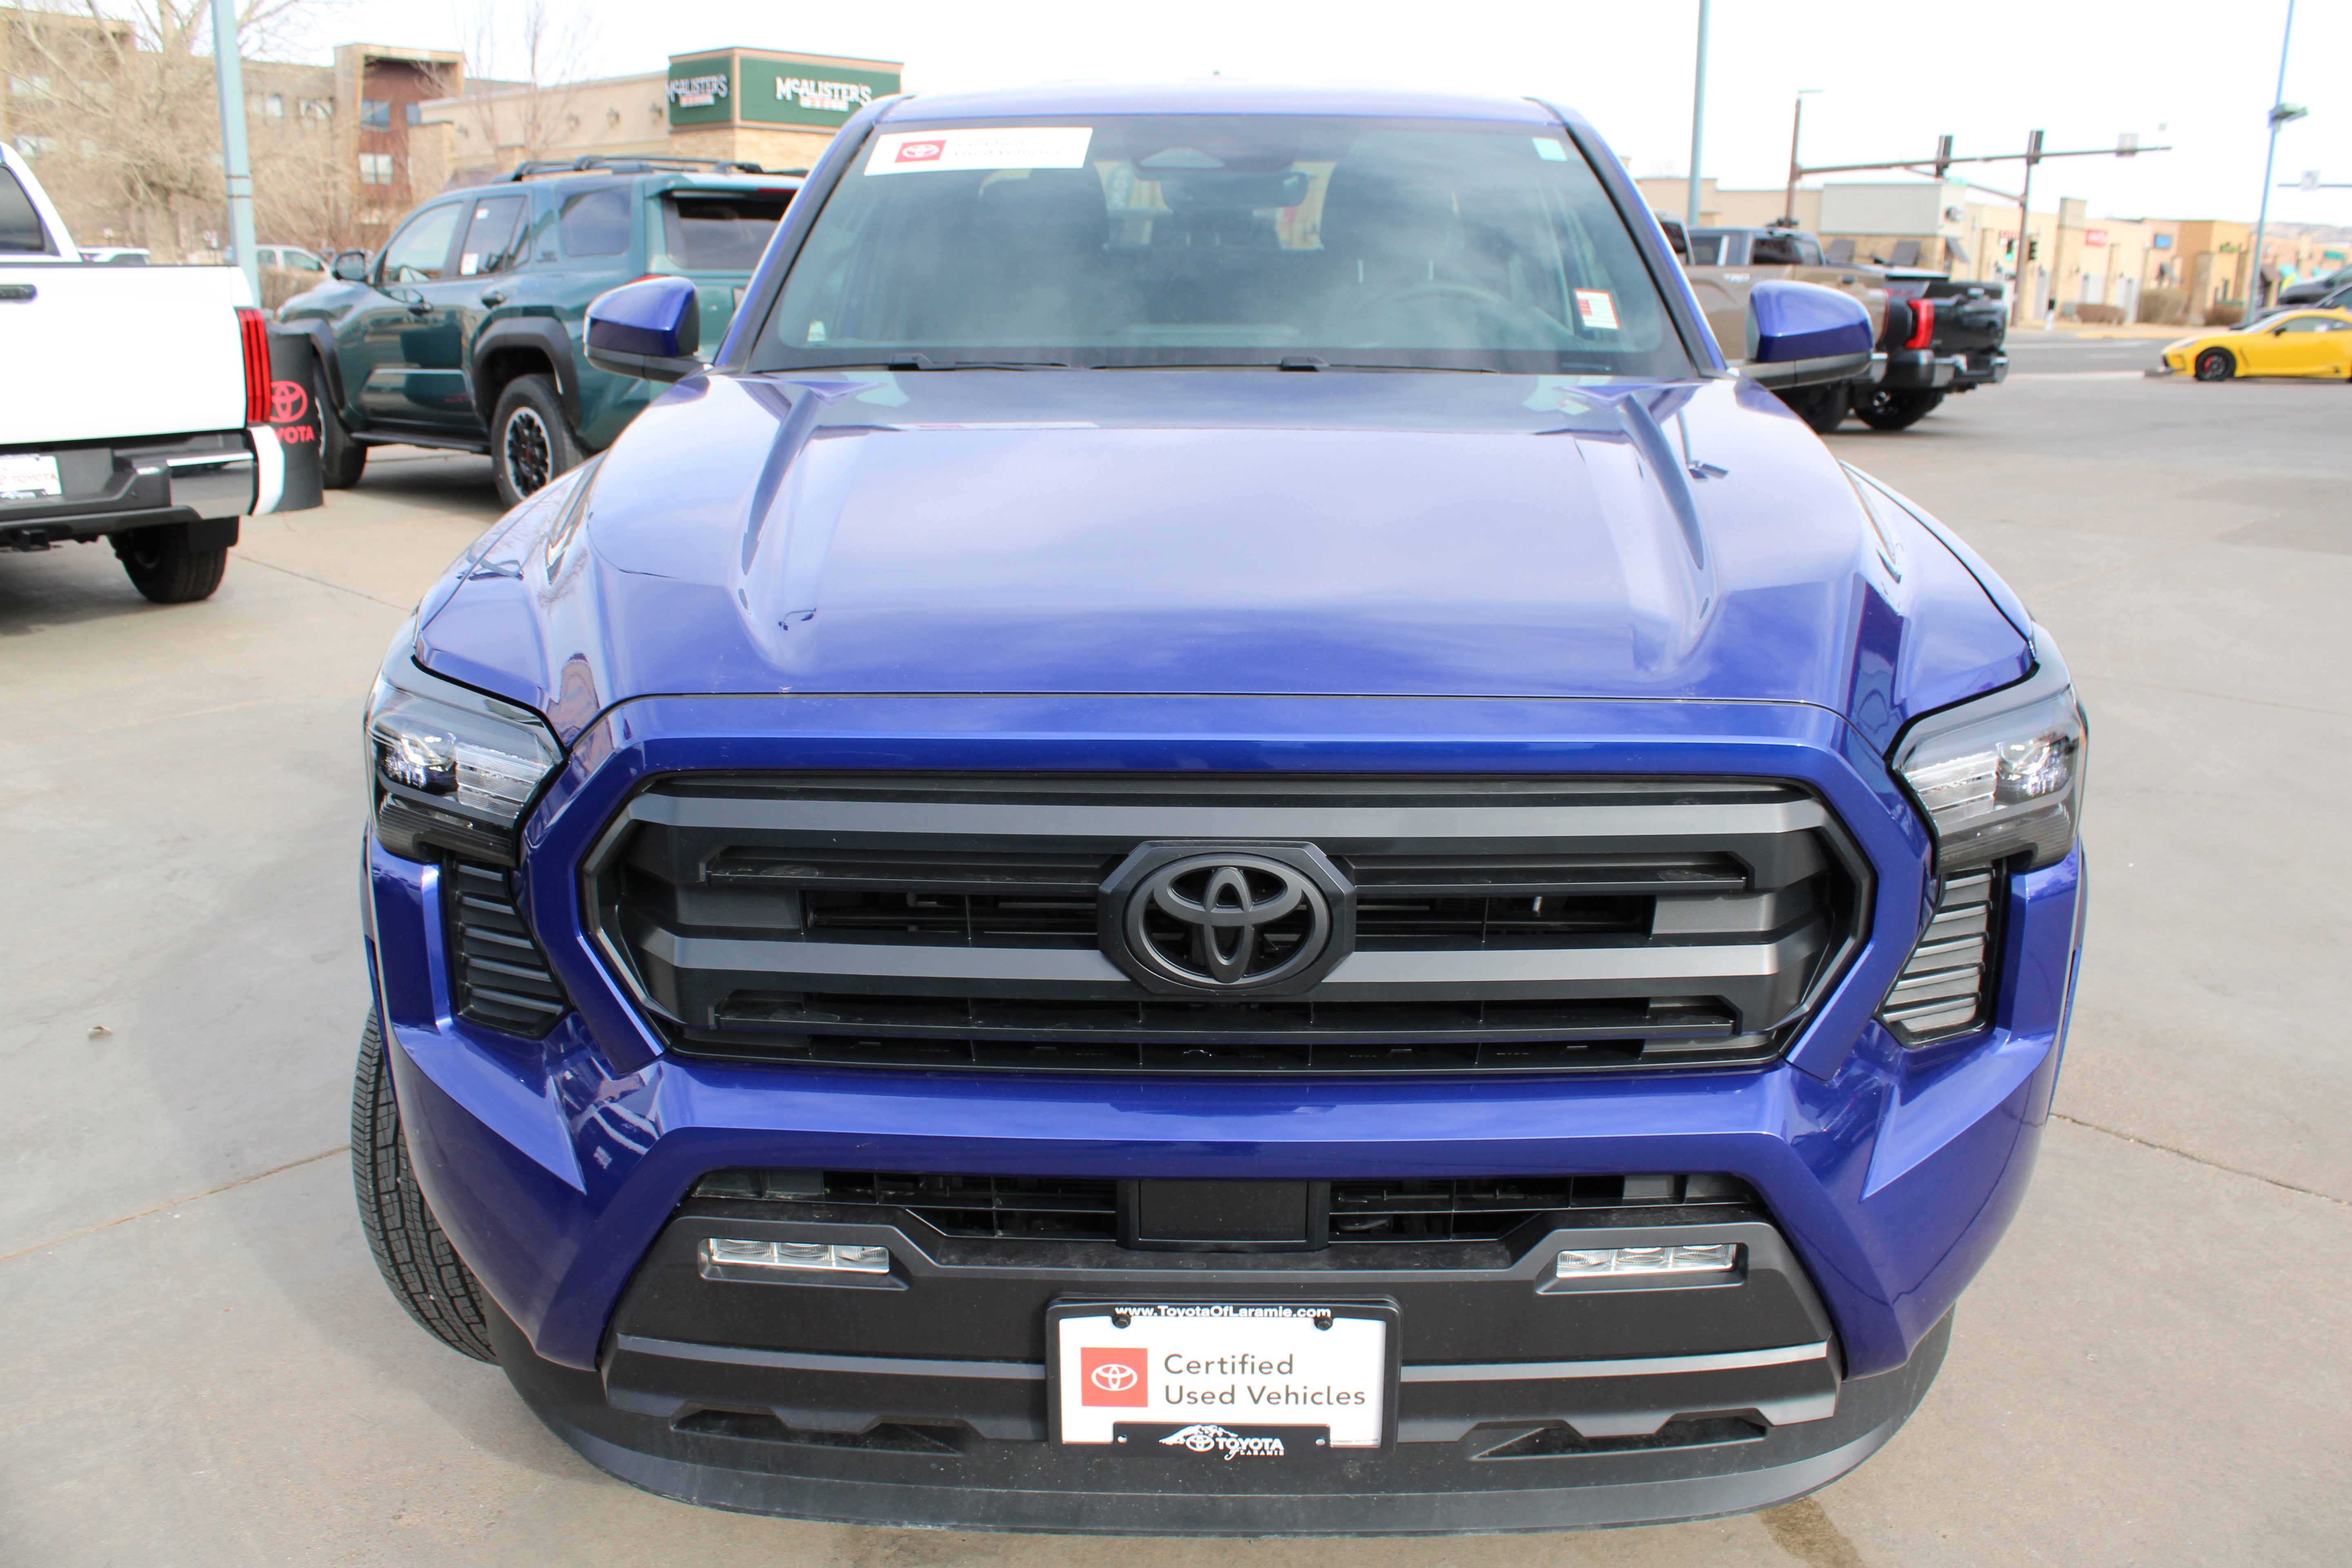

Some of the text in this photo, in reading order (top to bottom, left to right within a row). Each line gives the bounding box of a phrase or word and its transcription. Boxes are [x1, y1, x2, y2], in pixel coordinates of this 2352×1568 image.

[273, 425, 315, 444] YOTA
[11, 473, 58, 483] TOYOTA
[1114, 1305, 1331, 1318] www.ToyotaOfLaramie.com
[1164, 1353, 1293, 1375] Certified
[1165, 1384, 1365, 1405] Used Vehicles
[1215, 1437, 1285, 1450] TOYOTA
